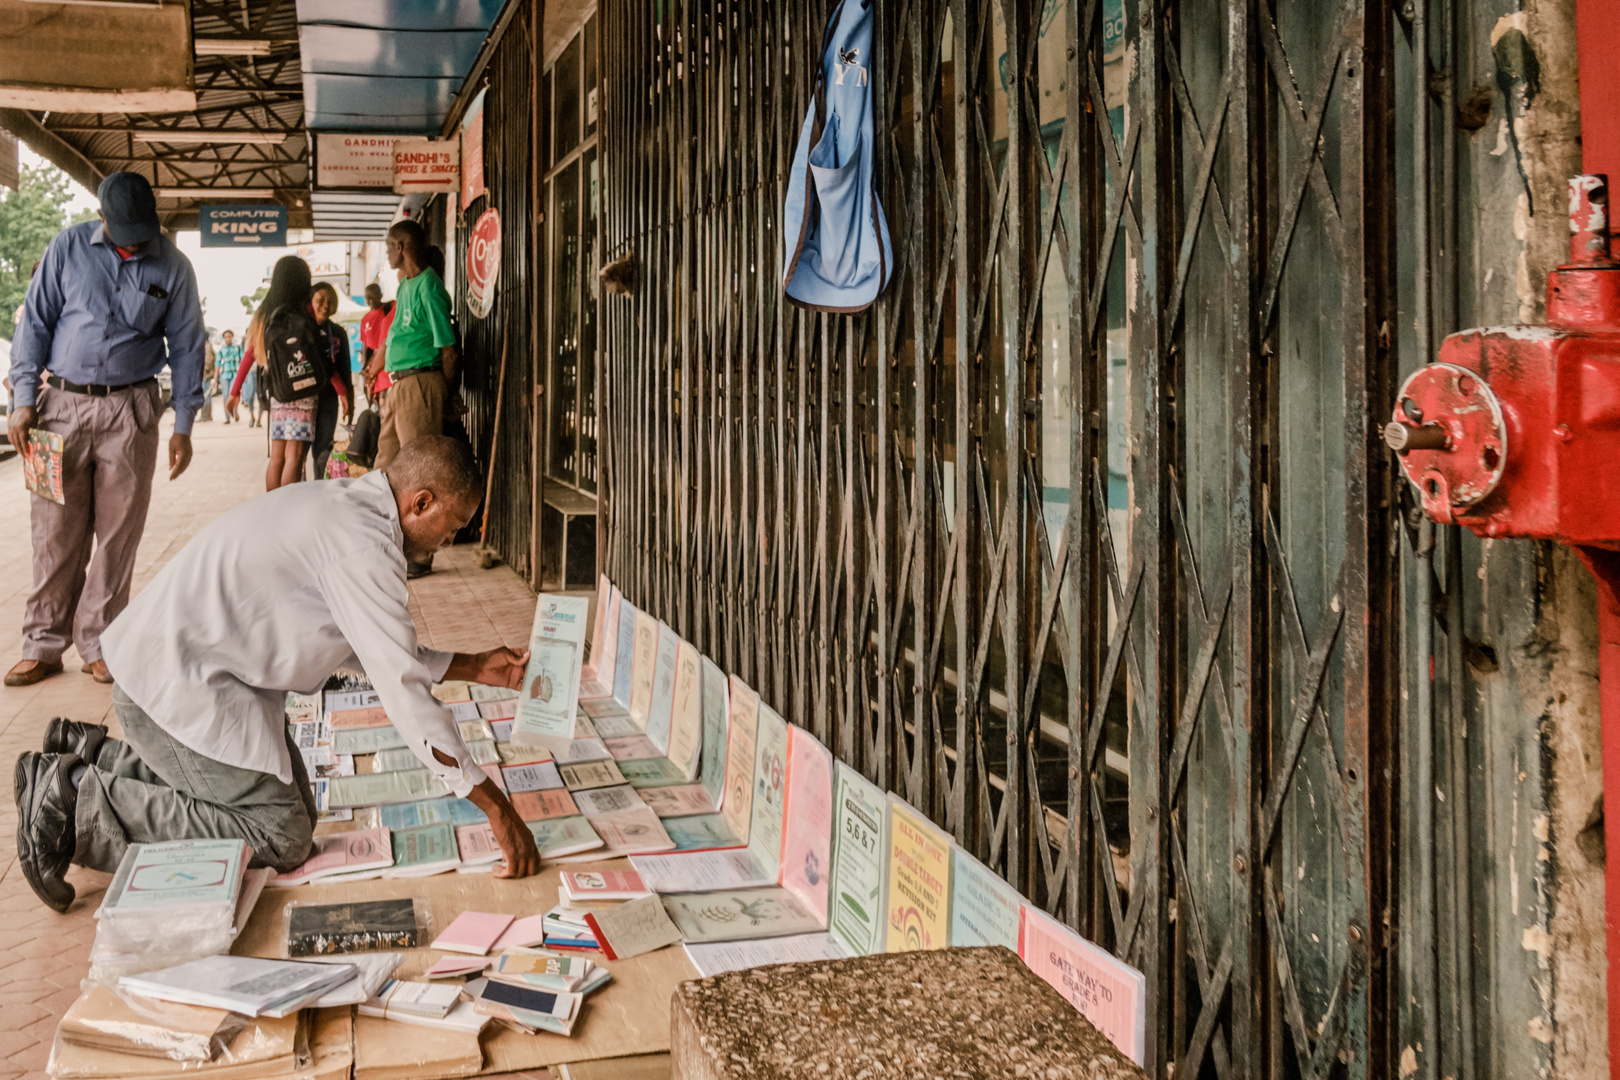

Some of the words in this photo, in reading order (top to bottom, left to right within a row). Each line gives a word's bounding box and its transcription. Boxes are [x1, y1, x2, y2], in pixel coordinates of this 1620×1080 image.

[394, 164, 418, 174] SPICES
[421, 164, 428, 174] &
[430, 164, 459, 174] SNACKS
[395, 152, 450, 164] GANDHI'S
[210, 210, 279, 219] COMPUTER
[211, 222, 278, 234] KING
[861, 830, 868, 849] &
[870, 837, 876, 854] 7
[899, 821, 914, 840] ALL
[915, 834, 925, 848] IN
[894, 844, 919, 877] DOUBLE
[918, 864, 944, 897] TARGET
[897, 880, 926, 911] REVISION
[925, 905, 937, 923] KIT
[922, 885, 935, 905] AND
[1049, 952, 1075, 977] GATE
[1076, 968, 1099, 992] WAY
[1099, 983, 1113, 1002] TO
[1062, 974, 1091, 1001] GRADE
